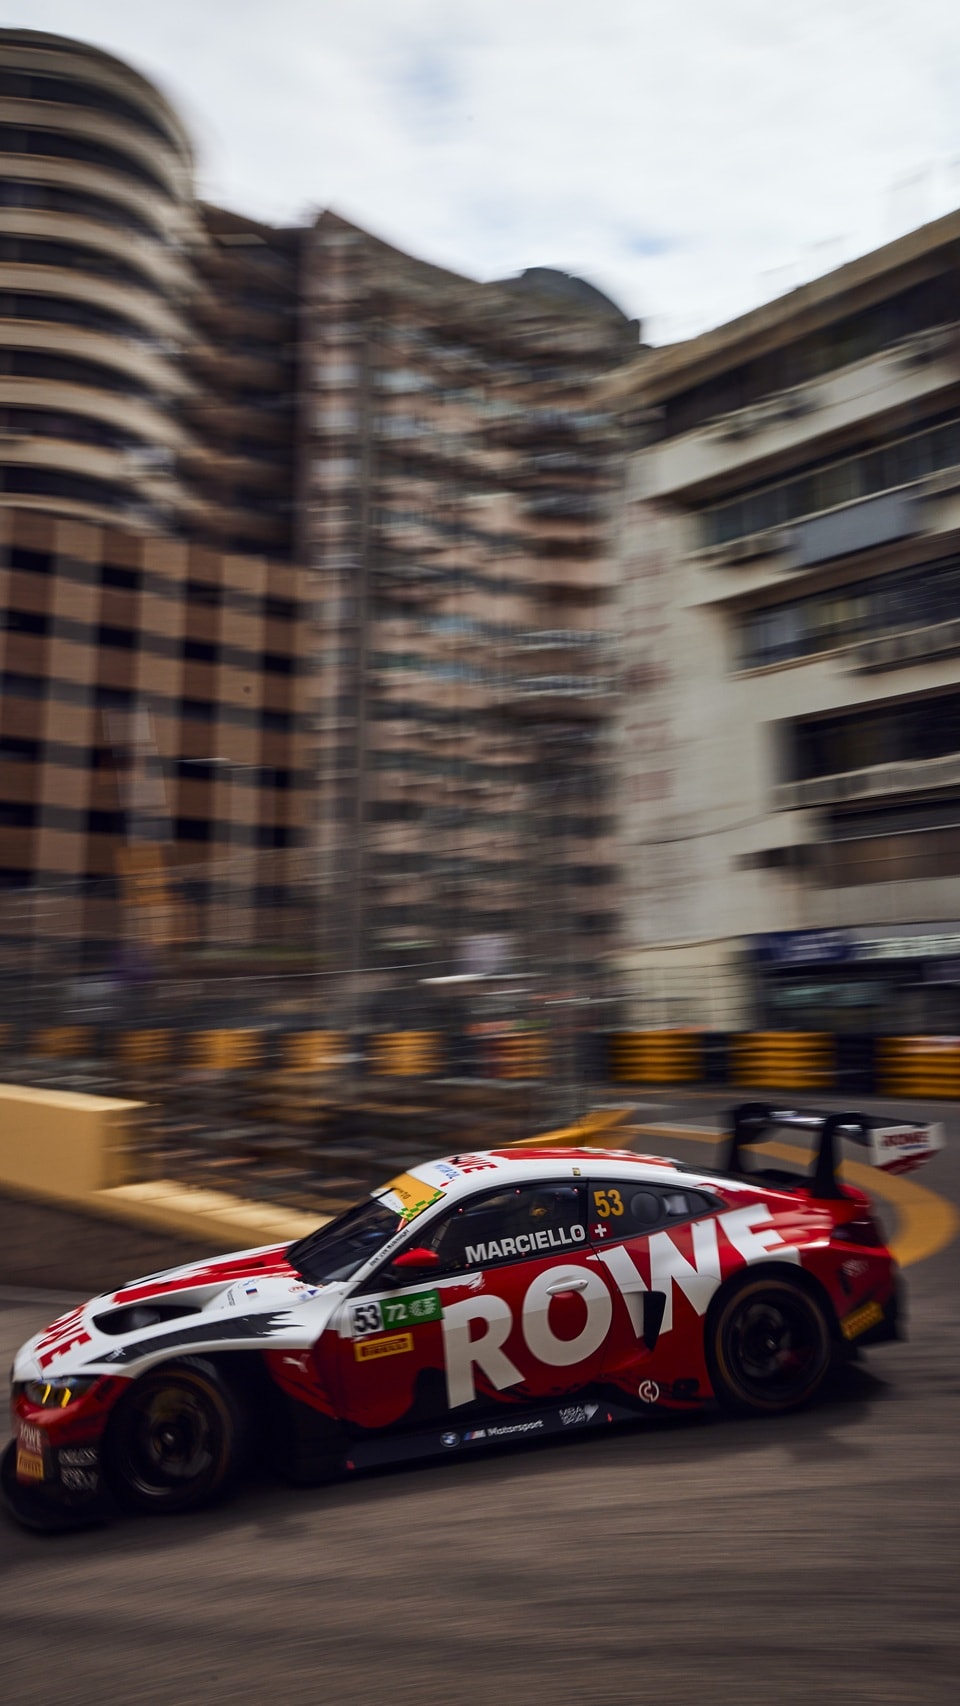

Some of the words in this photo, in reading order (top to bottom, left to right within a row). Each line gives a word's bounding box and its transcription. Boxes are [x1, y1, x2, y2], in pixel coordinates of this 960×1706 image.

[593, 1189, 624, 1218] 53
[464, 1224, 586, 1264] MARCIELLO
[354, 1304, 379, 1332] 53
[385, 1303, 408, 1322] 72
[441, 1203, 800, 1409] ROWE
[488, 1419, 544, 1437] Motorsport
